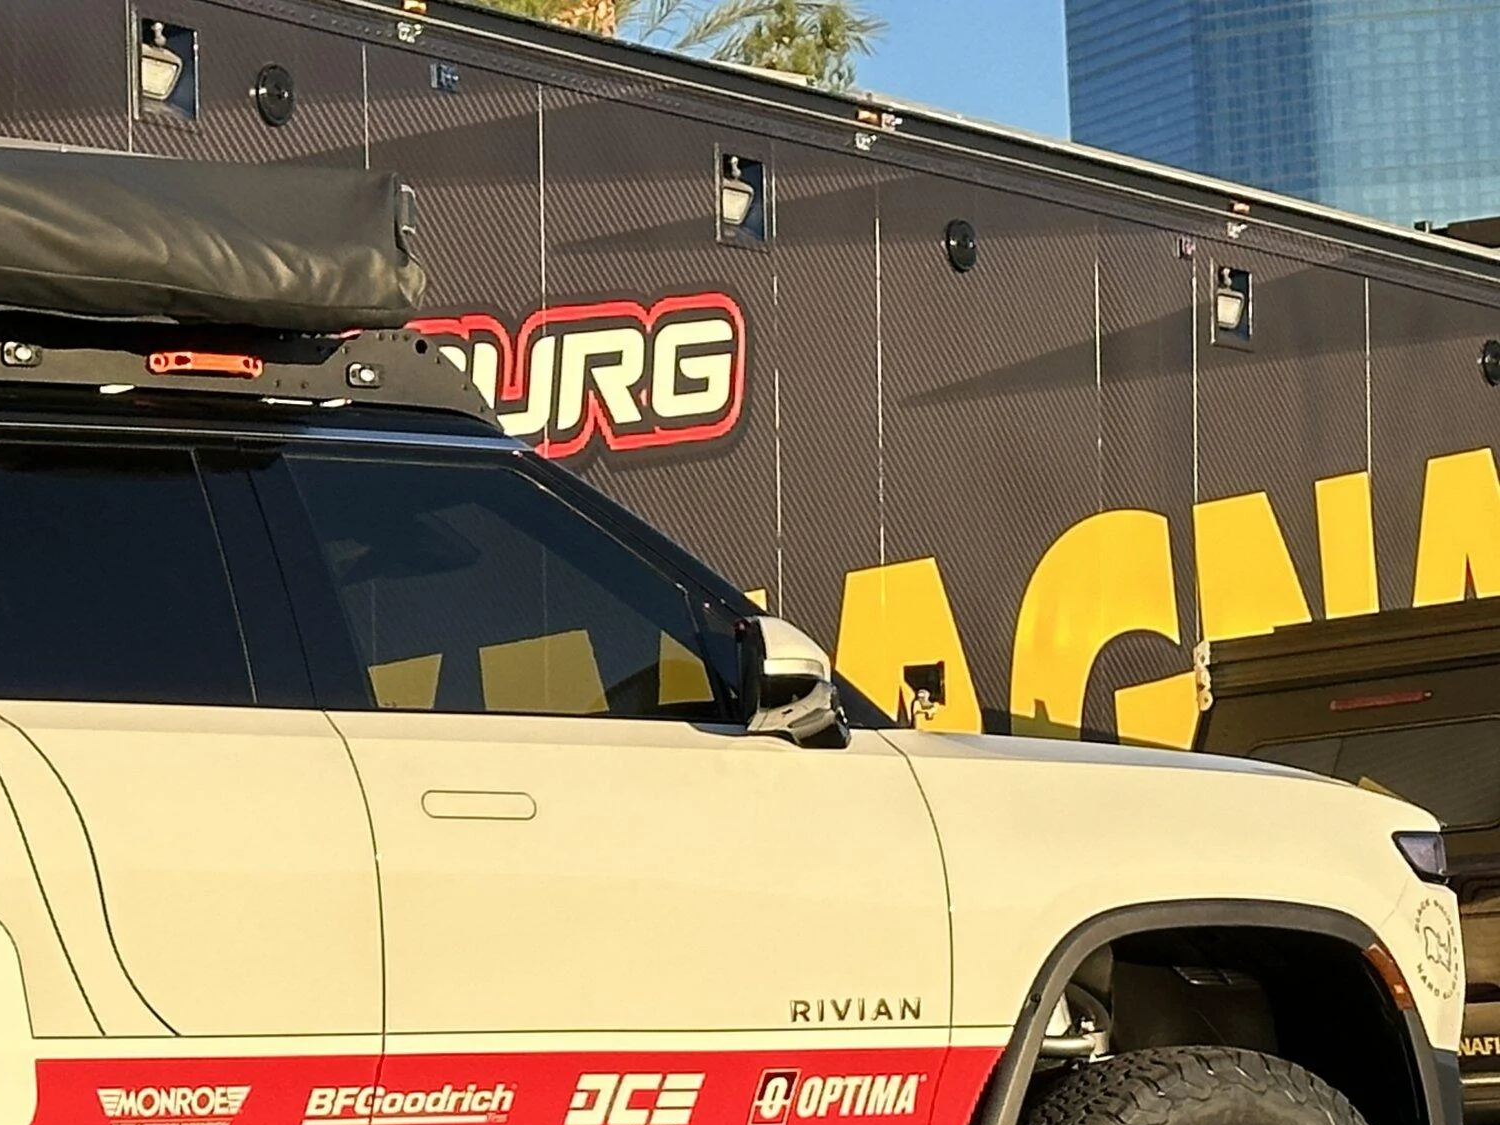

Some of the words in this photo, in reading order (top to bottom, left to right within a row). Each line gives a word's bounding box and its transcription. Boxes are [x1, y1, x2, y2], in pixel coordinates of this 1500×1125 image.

[438, 318, 734, 437] URG
[790, 997, 922, 1022] RIVIAN
[115, 1085, 231, 1117] MONROE
[304, 1083, 515, 1117] BFGoodrich
[796, 1074, 920, 1118] OPTIMA
